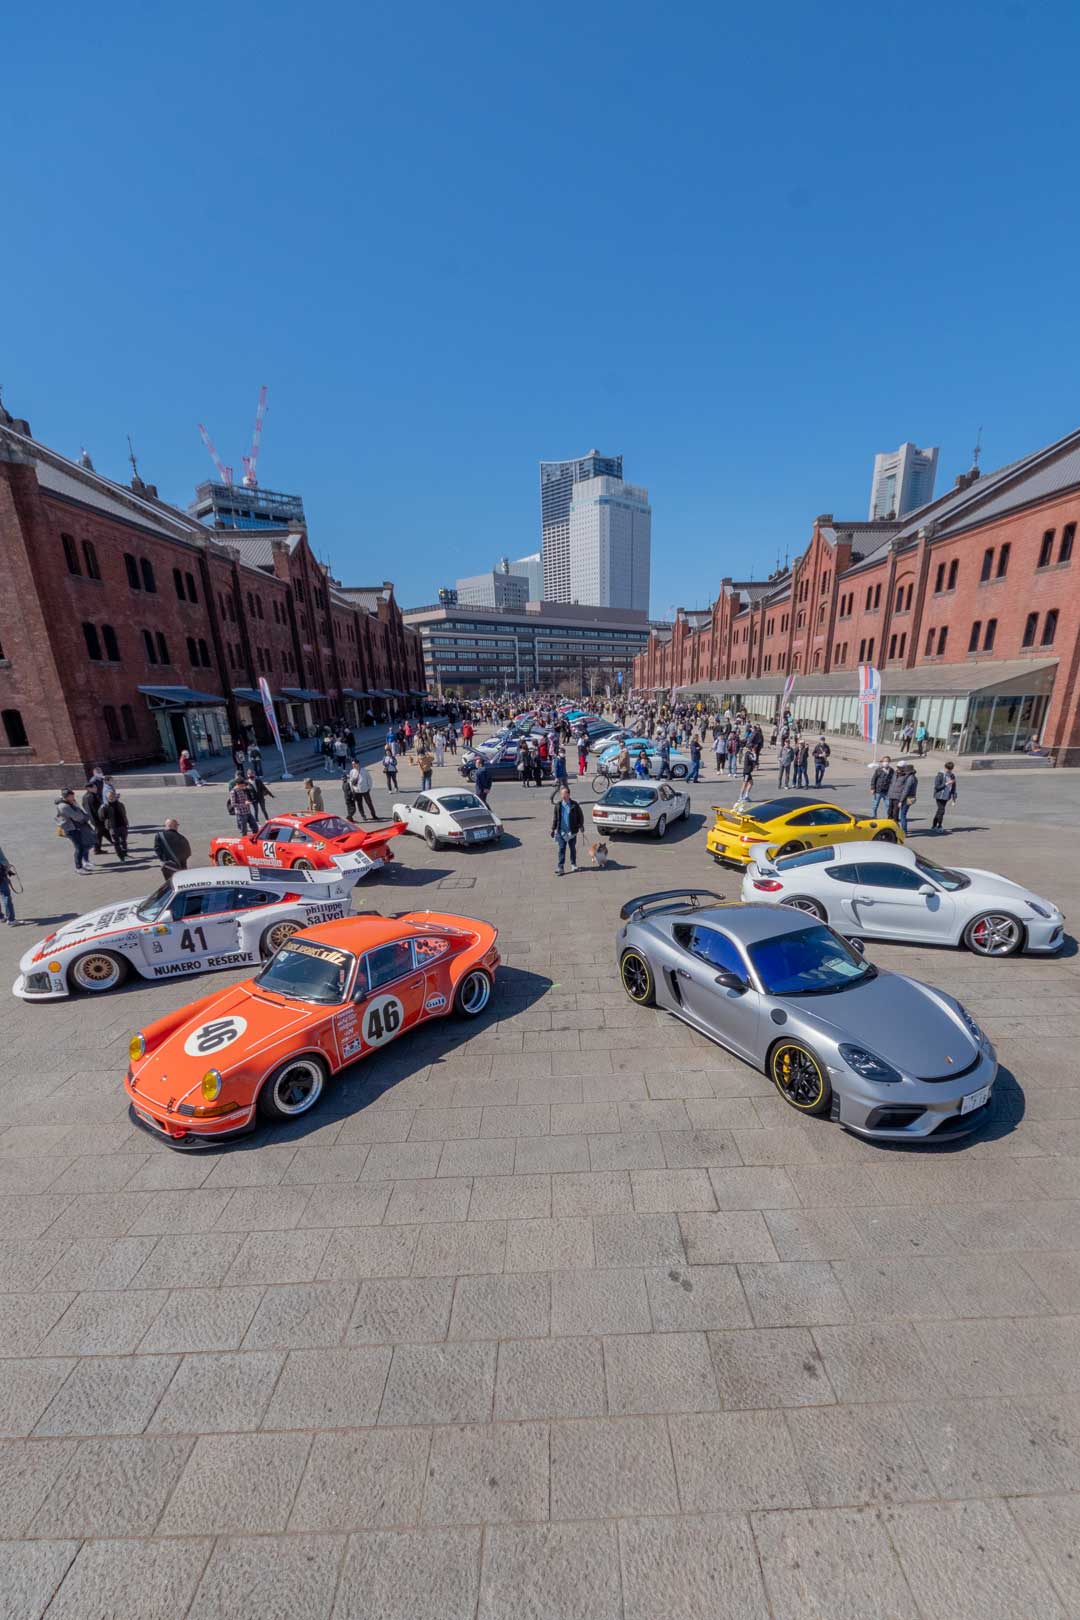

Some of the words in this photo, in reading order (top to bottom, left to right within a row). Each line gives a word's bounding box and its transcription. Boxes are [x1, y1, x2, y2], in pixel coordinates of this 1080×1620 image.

[263, 842, 276, 857] 24
[178, 881, 212, 890] NUMERO
[305, 902, 342, 916] philippe
[307, 909, 345, 925] salvet
[181, 926, 208, 953] 41
[153, 960, 202, 976] NUMERO
[207, 952, 254, 967] RESERVE
[367, 1000, 400, 1040] 46
[196, 1019, 238, 1052] 46
